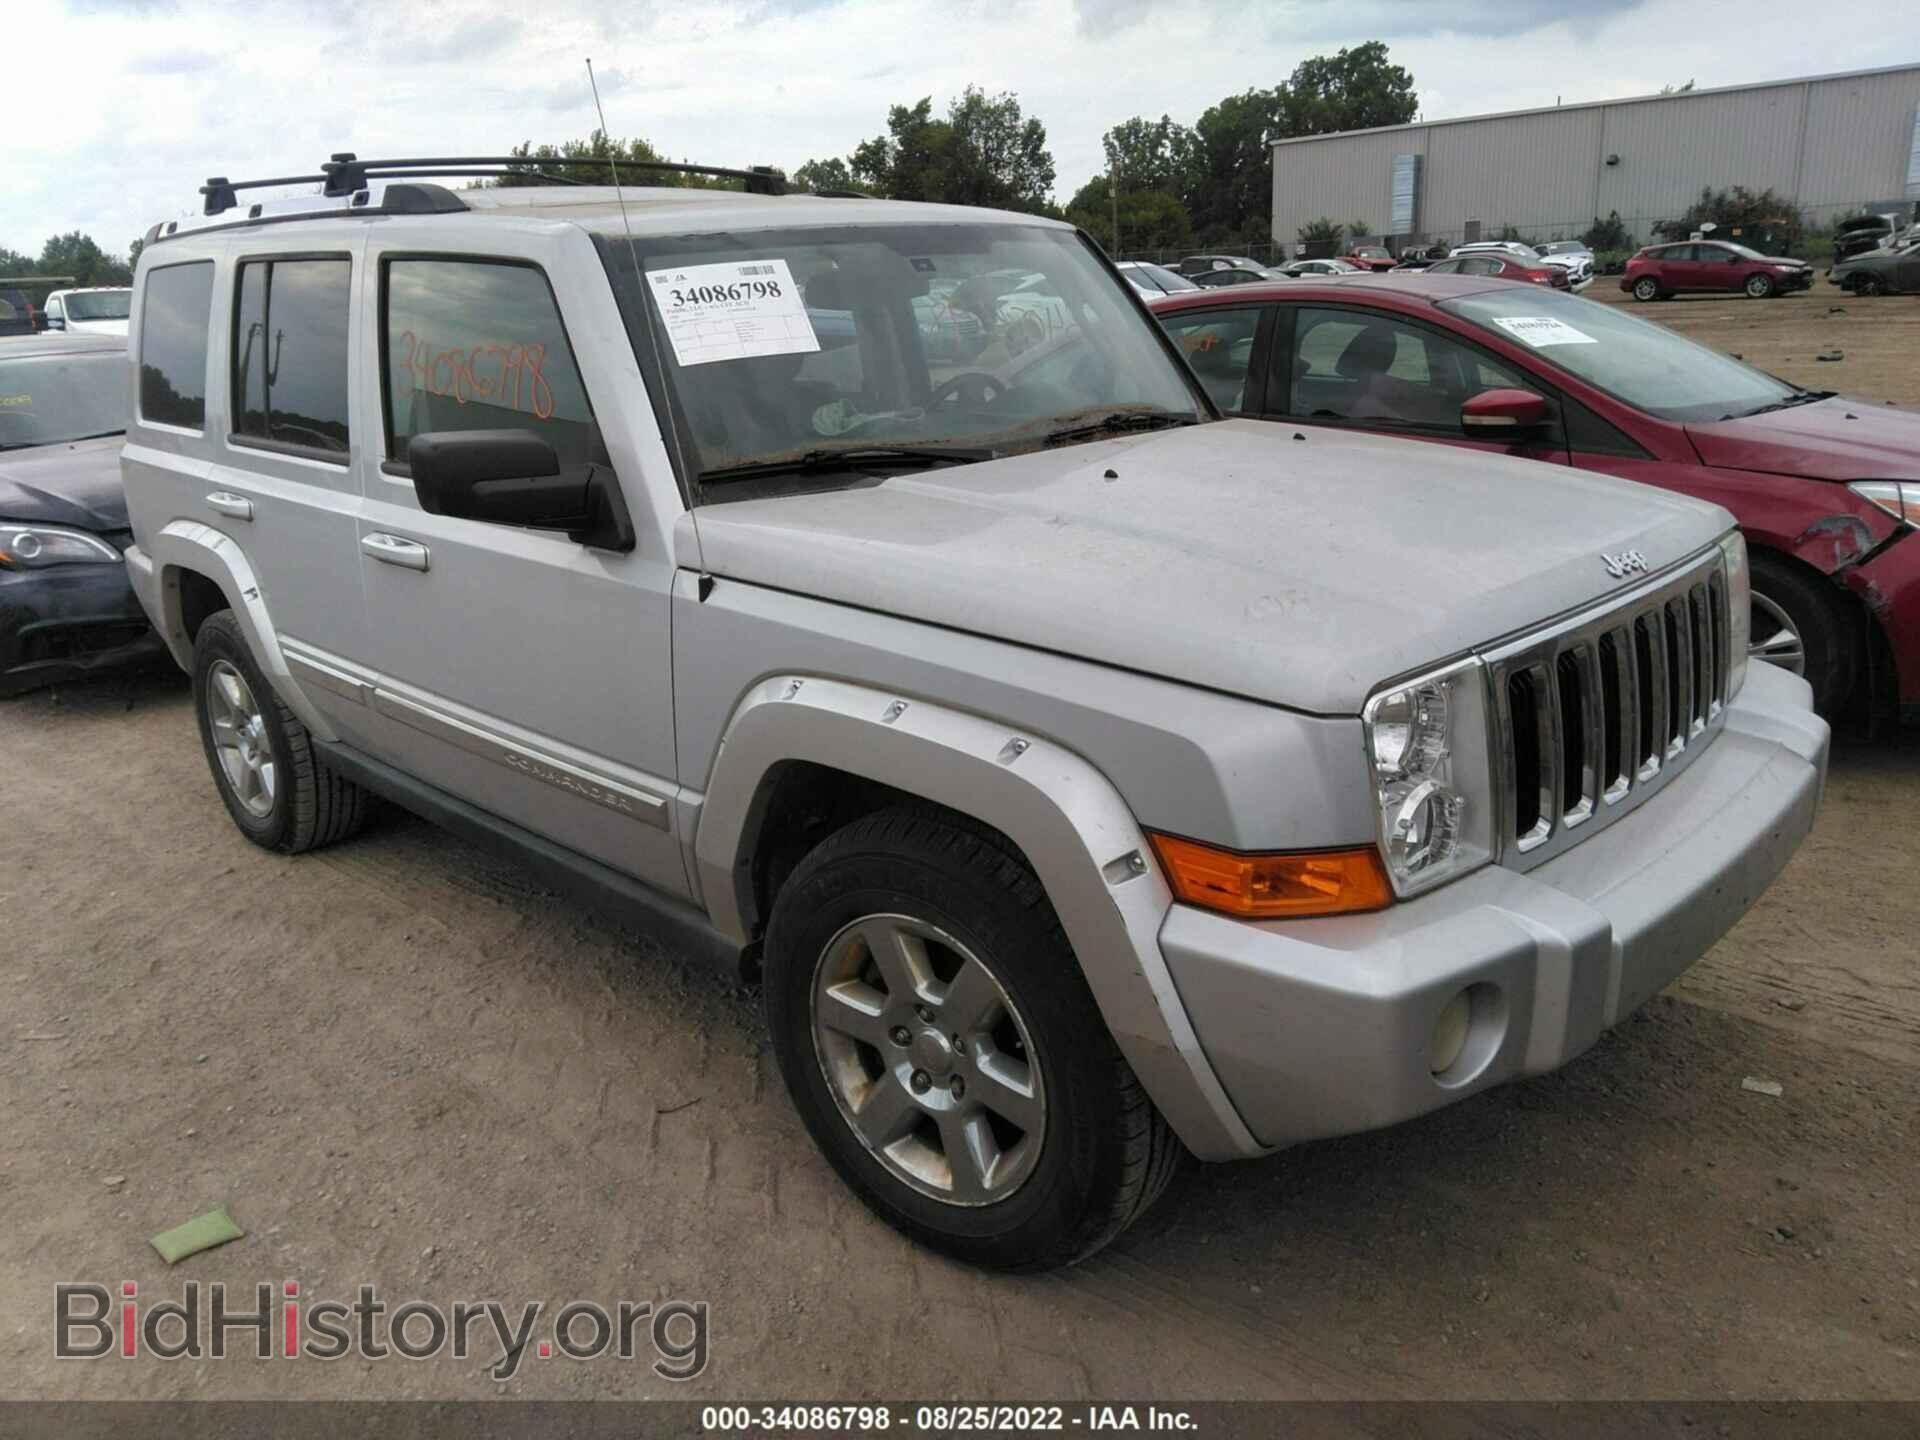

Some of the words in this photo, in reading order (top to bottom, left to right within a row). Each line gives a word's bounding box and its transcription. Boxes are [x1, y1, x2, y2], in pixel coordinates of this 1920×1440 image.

[669, 280, 782, 307] 34086798
[400, 330, 553, 419] 34086798
[1600, 551, 1648, 579] Jeep
